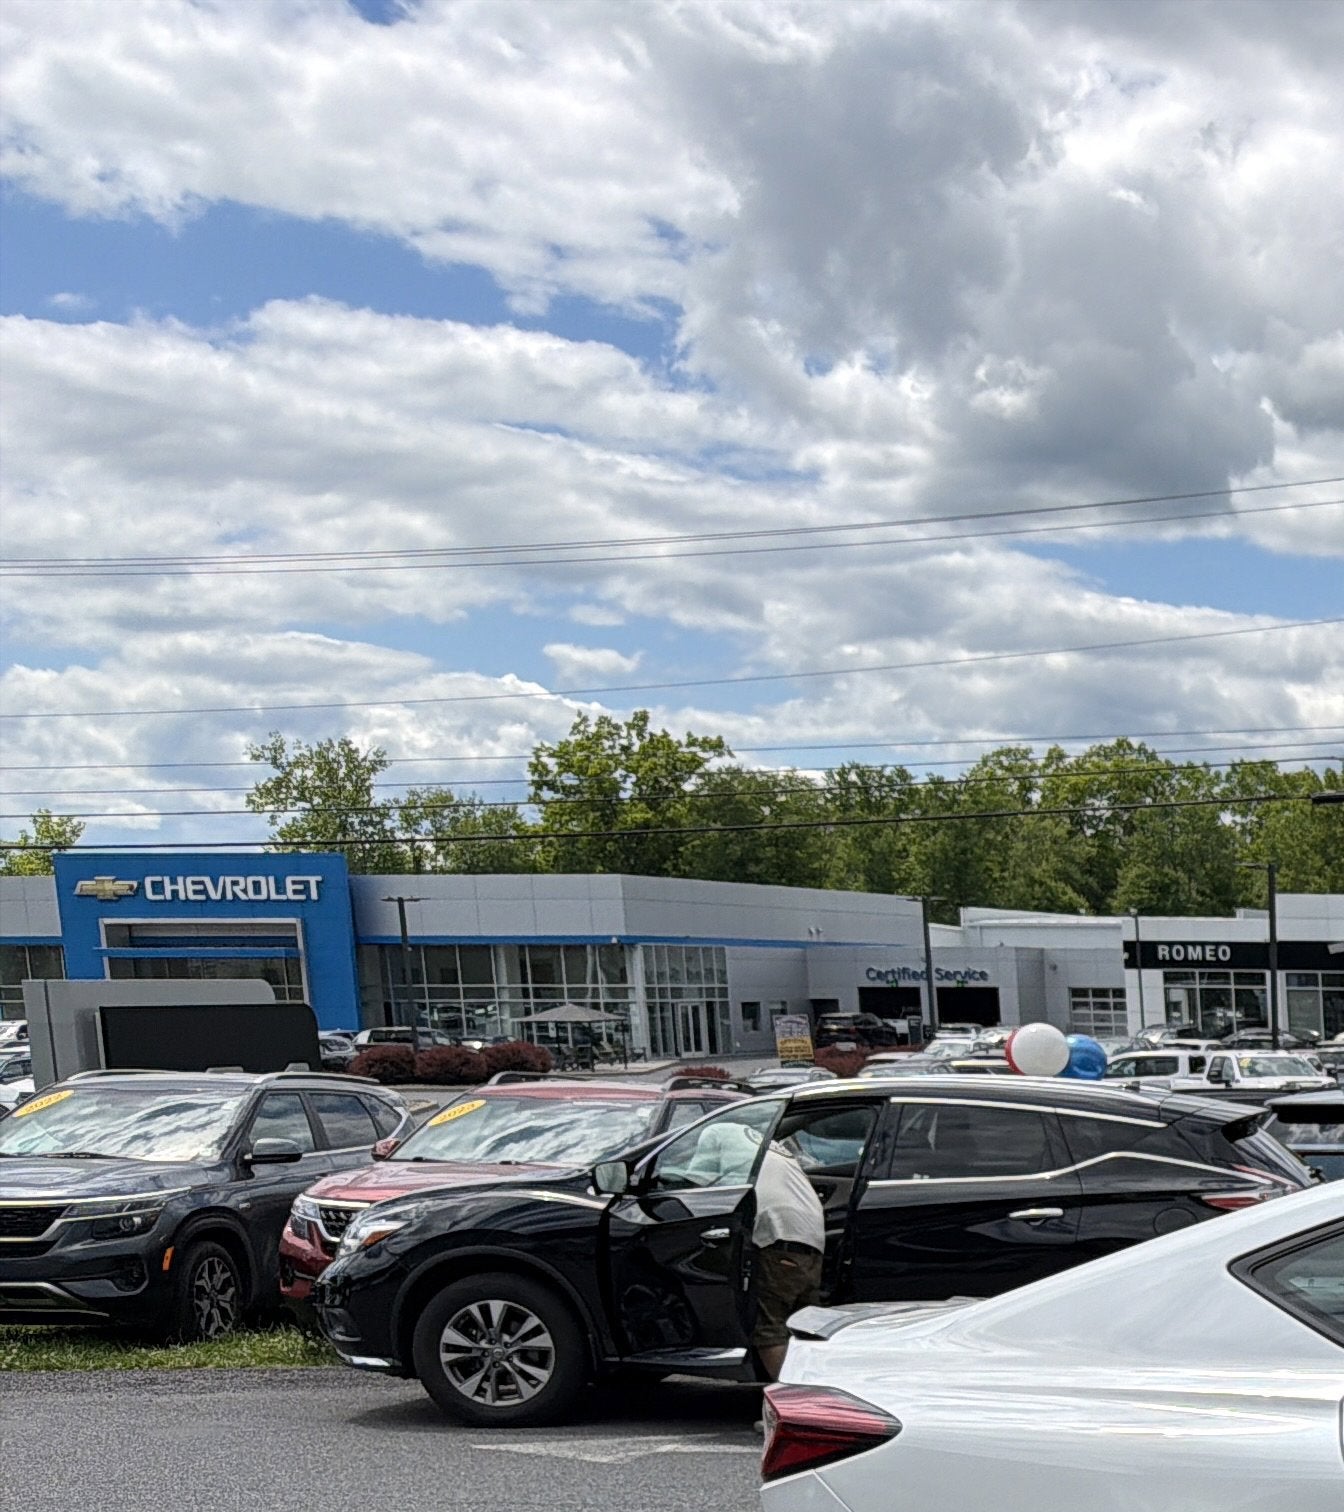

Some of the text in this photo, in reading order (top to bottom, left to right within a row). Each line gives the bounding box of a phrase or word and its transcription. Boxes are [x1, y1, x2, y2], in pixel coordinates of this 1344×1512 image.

[144, 875, 323, 901] CHEVROLET
[1157, 944, 1232, 962] ROMEO
[865, 966, 989, 981] Certified Service
